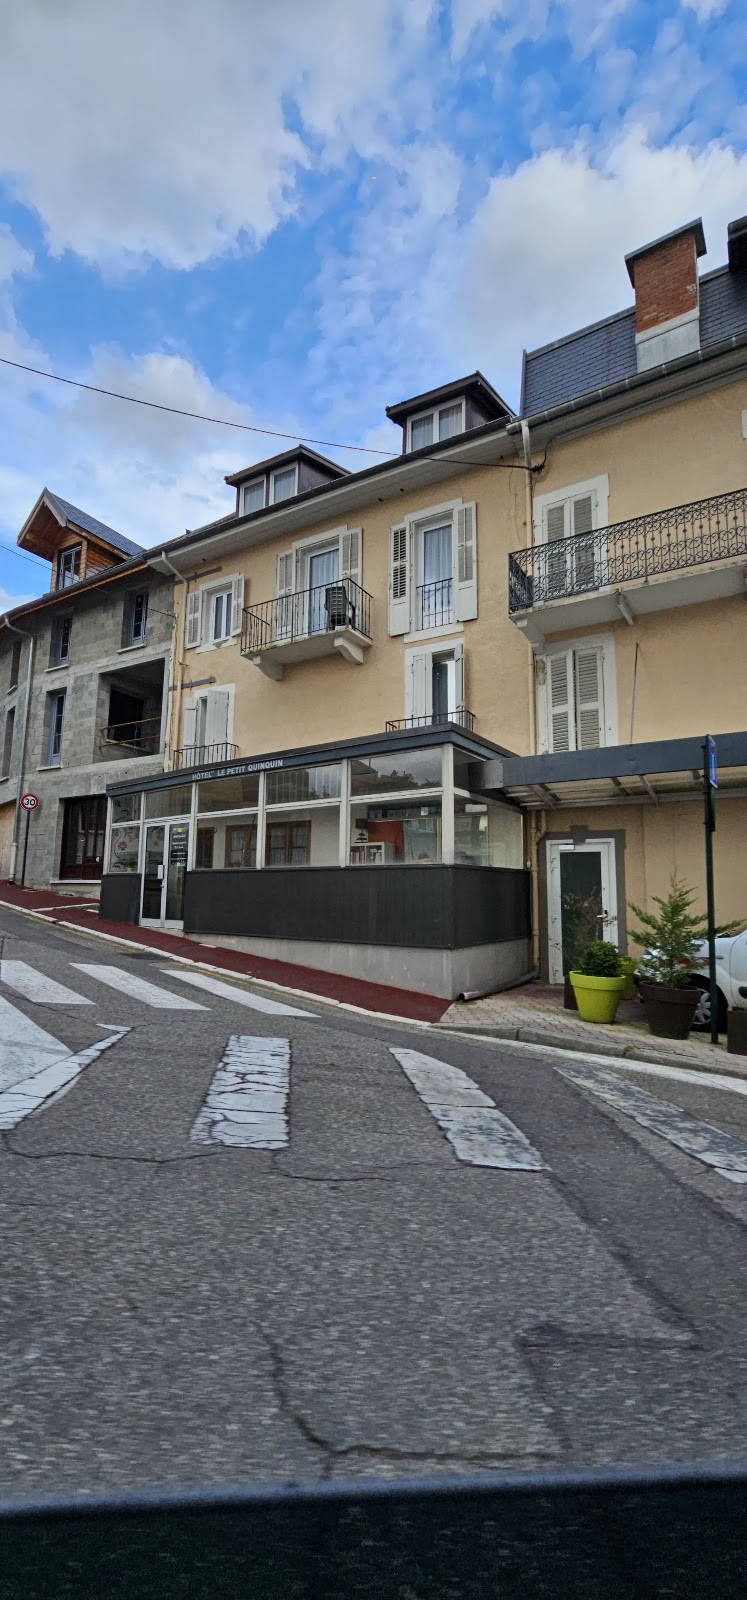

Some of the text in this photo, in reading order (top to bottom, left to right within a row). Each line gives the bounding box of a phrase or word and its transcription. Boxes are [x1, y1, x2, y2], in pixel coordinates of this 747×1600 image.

[217, 769, 226, 777] LE
[227, 766, 246, 775] PETIT
[247, 760, 283, 771] QUINQUIN
[24, 798, 35, 806] 30
